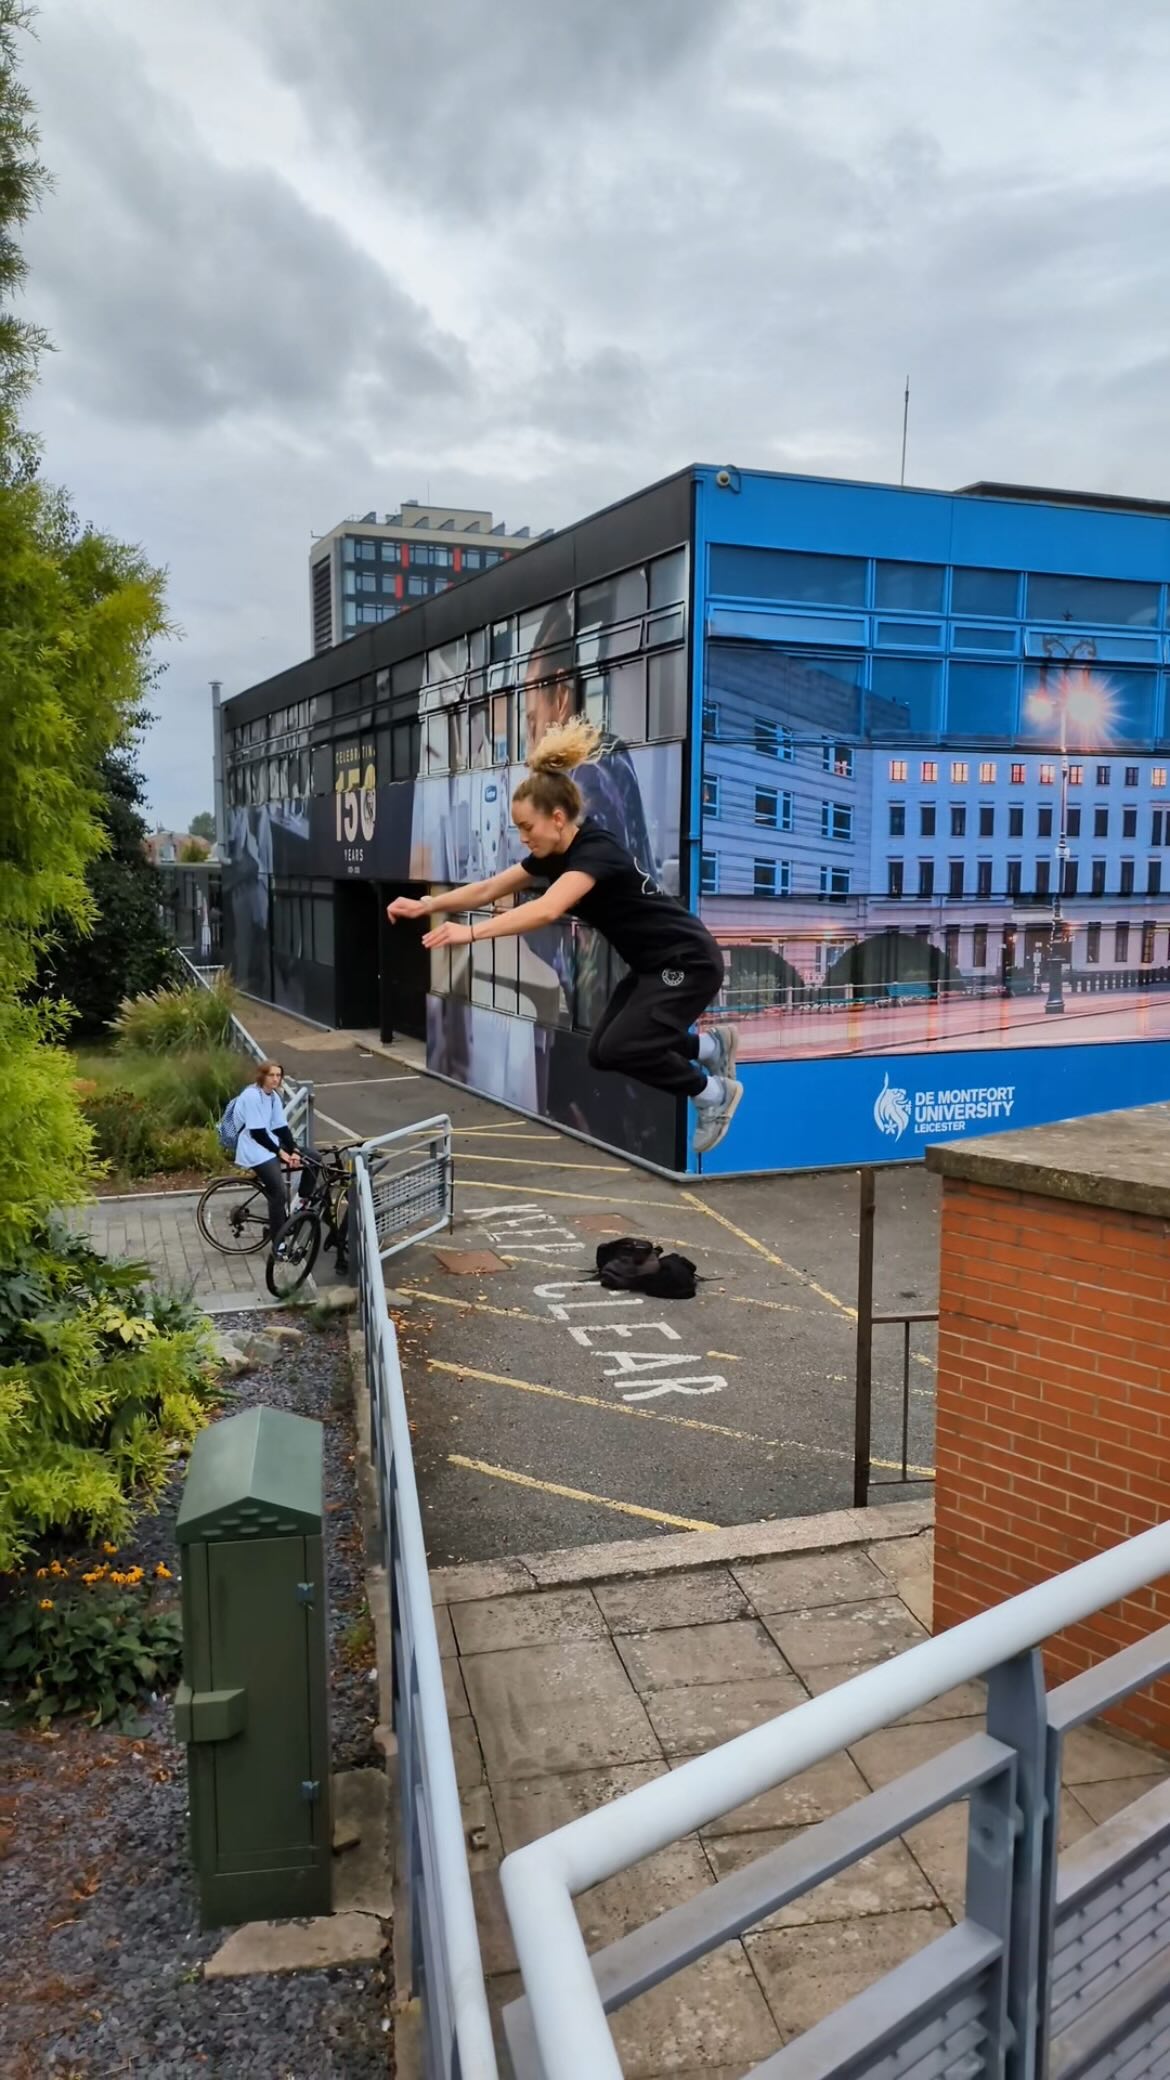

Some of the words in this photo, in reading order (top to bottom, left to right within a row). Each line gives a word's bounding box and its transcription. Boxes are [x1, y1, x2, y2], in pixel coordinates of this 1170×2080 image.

[335, 763, 376, 842] 150
[344, 848, 364, 862] YEARS
[915, 1091, 934, 1106] DE
[938, 1086, 1016, 1104] MONTFORT
[914, 1100, 1014, 1122] UNIVERSITY
[914, 1121, 966, 1134] LEICESTER
[463, 1203, 586, 1254] KEEP
[533, 1281, 728, 1401] CLEAR
